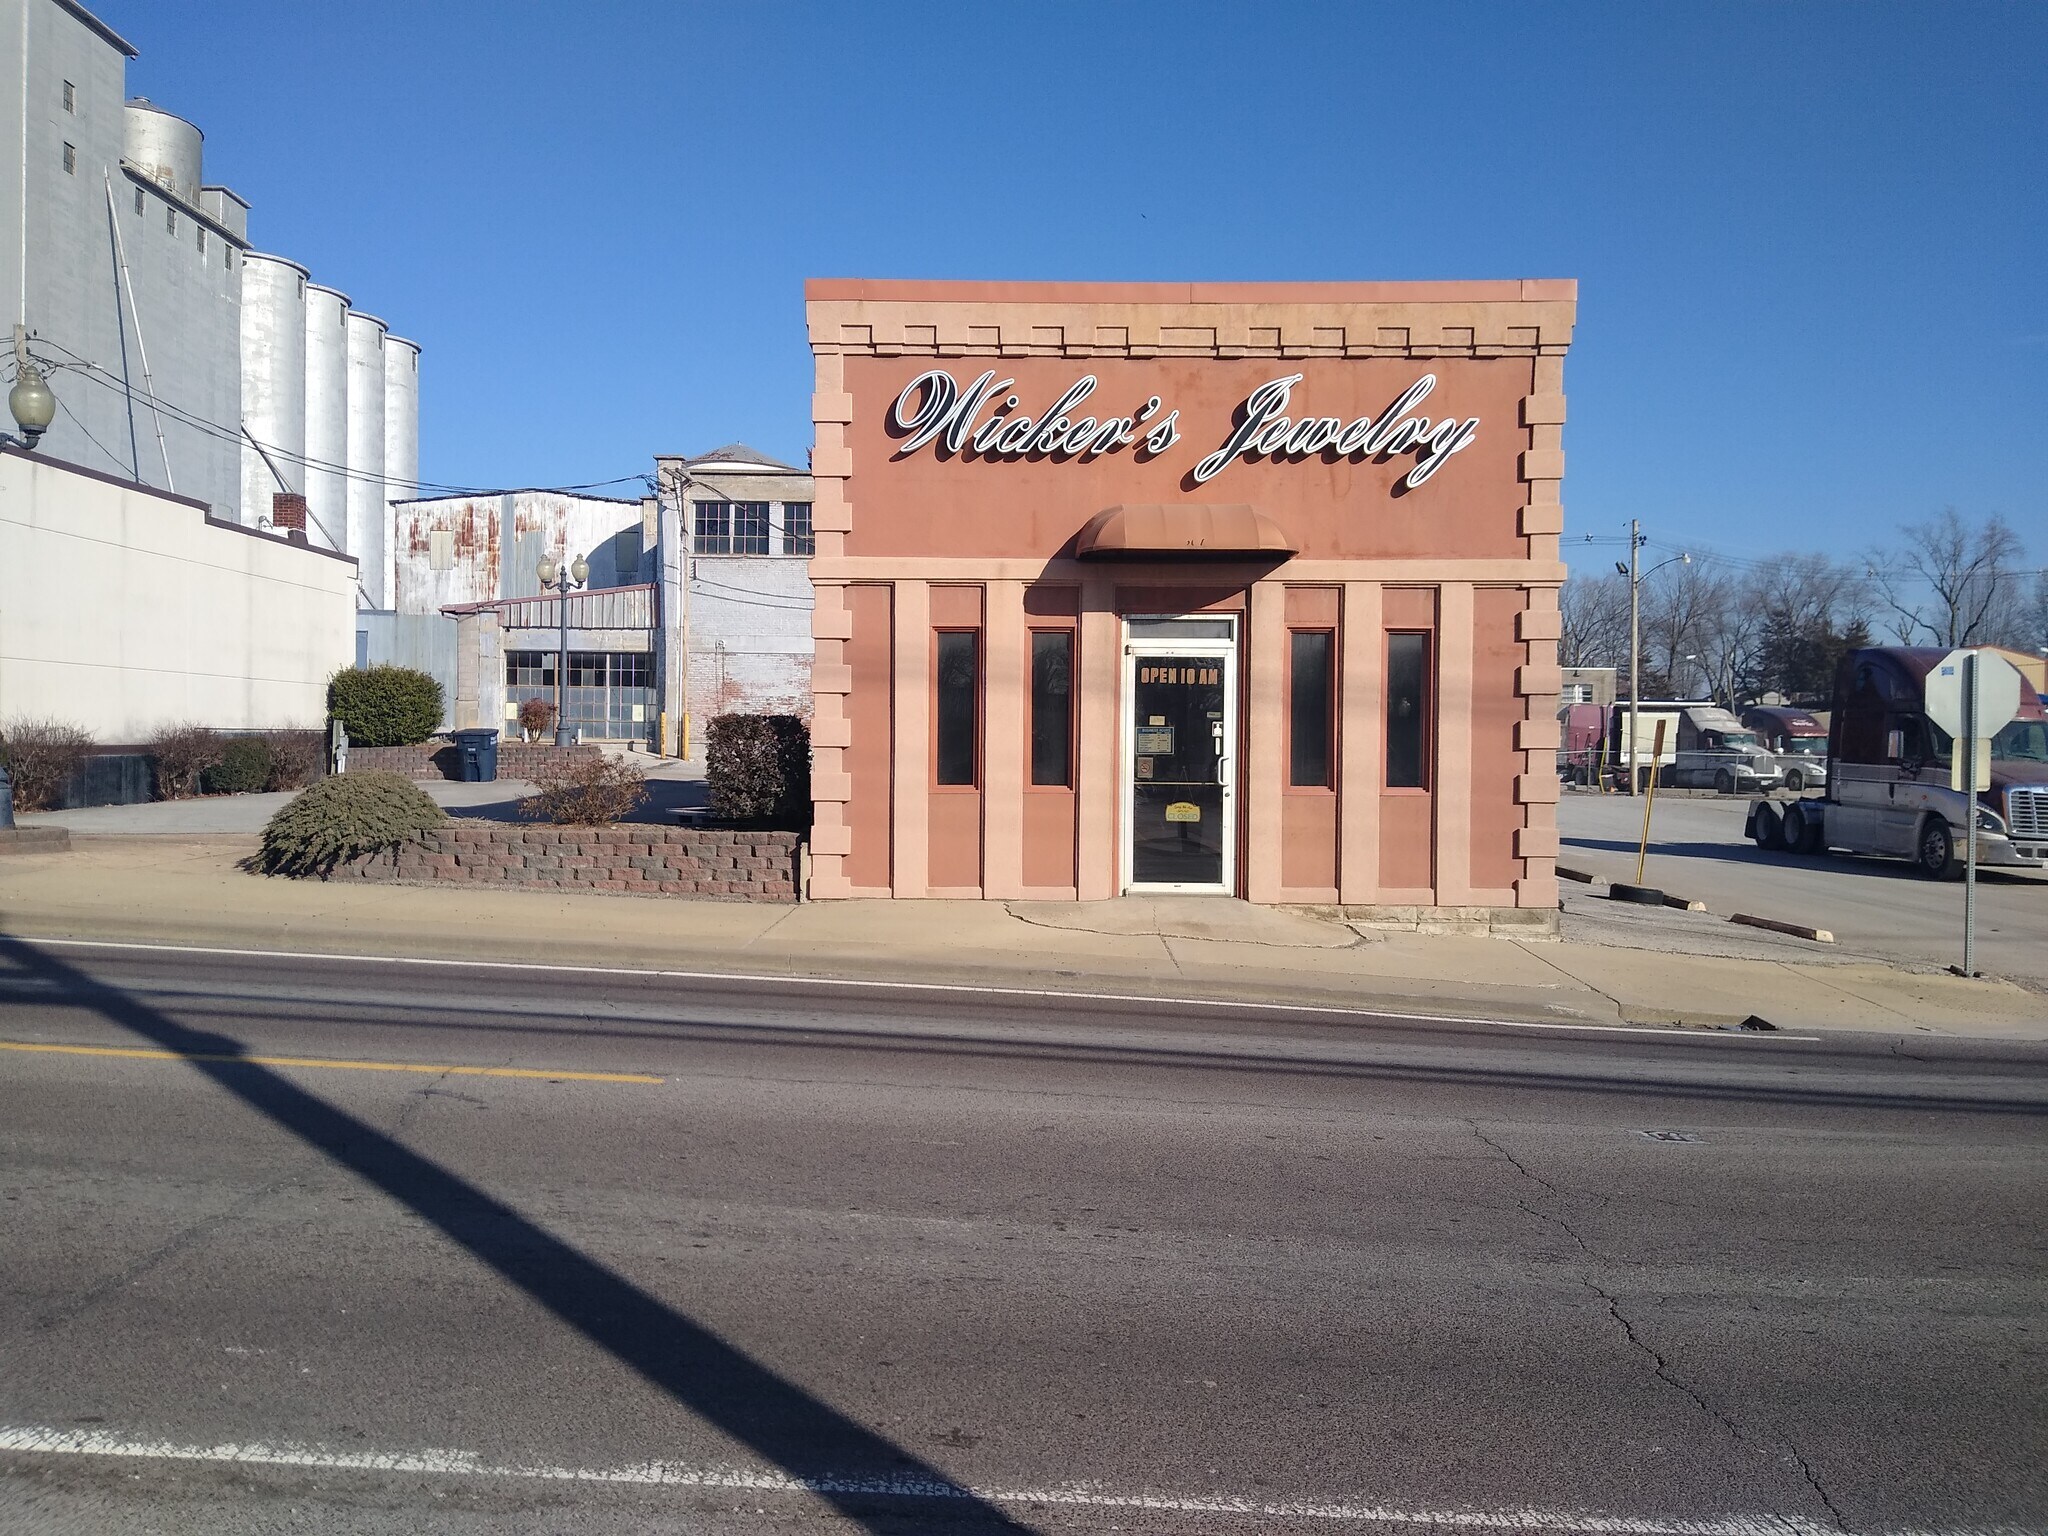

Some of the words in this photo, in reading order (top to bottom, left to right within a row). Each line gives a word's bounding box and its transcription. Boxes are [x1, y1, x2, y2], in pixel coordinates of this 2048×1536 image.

[895, 368, 1183, 455] Wicker's
[1193, 372, 1481, 489] Jewelry
[1141, 667, 1177, 684] OPEN
[1180, 668, 1195, 685] 10
[1198, 668, 1218, 685] AM
[1167, 812, 1198, 820] CLOSED
